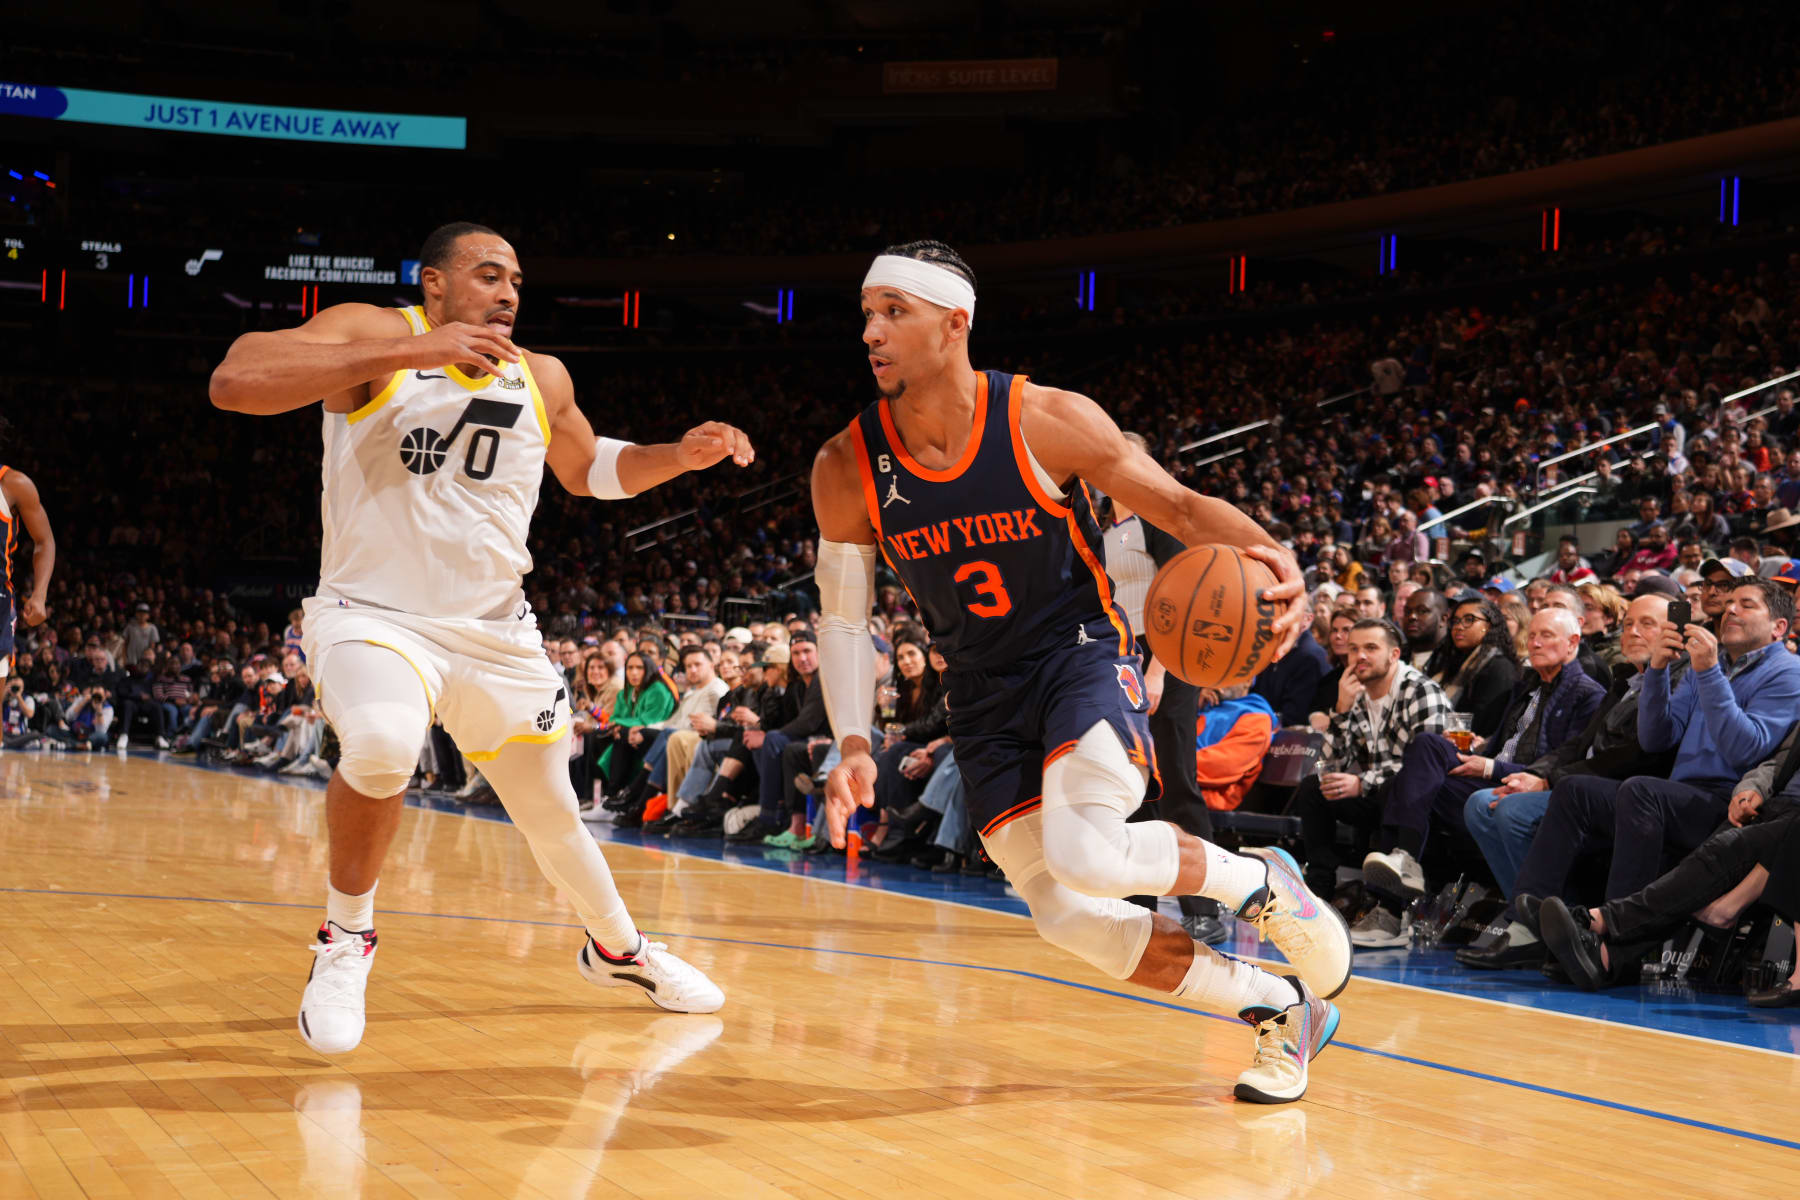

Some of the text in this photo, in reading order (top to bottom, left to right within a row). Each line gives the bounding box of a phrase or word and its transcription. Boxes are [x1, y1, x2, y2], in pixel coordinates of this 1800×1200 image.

[946, 69, 995, 85] SUITE
[999, 67, 1050, 83] LEVEL
[144, 104, 400, 140] JUST 1 AVENUE AWAY
[7, 248, 18, 260] 4
[81, 241, 122, 253] STEALS
[95, 253, 108, 270] 3
[288, 254, 375, 271] LIKE THE KNICKS!
[264, 266, 397, 285] FACEBOOK.COM/NYKNICKS
[464, 428, 500, 481] 0
[877, 454, 892, 473] 6
[887, 508, 1043, 561] NEW YORK
[953, 560, 1013, 618] 3
